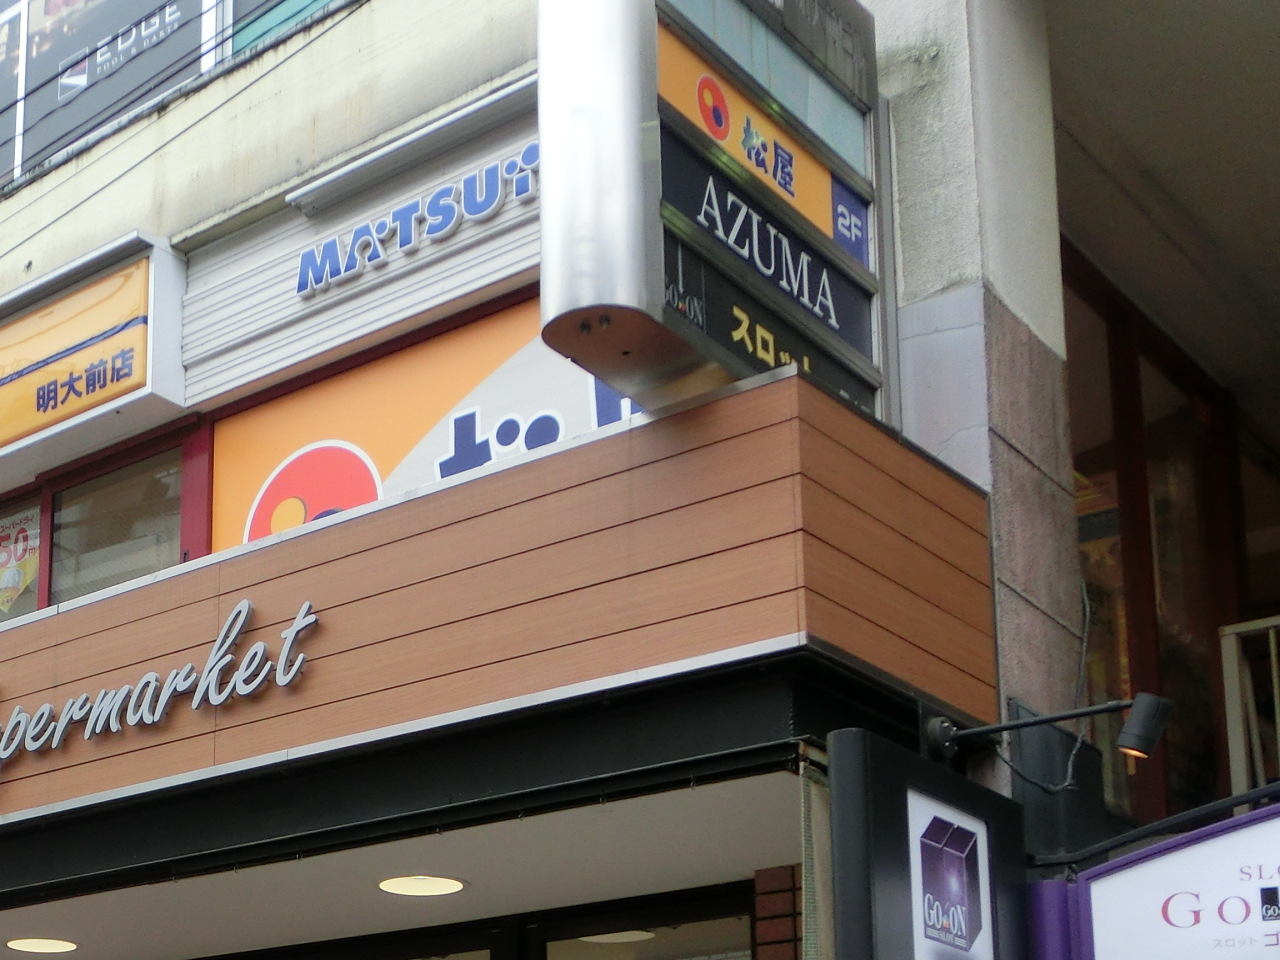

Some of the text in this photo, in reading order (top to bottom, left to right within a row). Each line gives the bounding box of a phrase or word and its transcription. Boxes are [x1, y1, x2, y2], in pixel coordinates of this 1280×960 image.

[97, 4, 181, 63] EDGE
[741, 115, 794, 197] 松屋
[297, 141, 540, 296] MATSUY
[836, 203, 862, 241] 2F
[697, 175, 840, 330] AZUMA
[731, 305, 811, 373] スロ
[36, 348, 135, 414] 明大前店
[1239, 864, 1280, 881] SL
